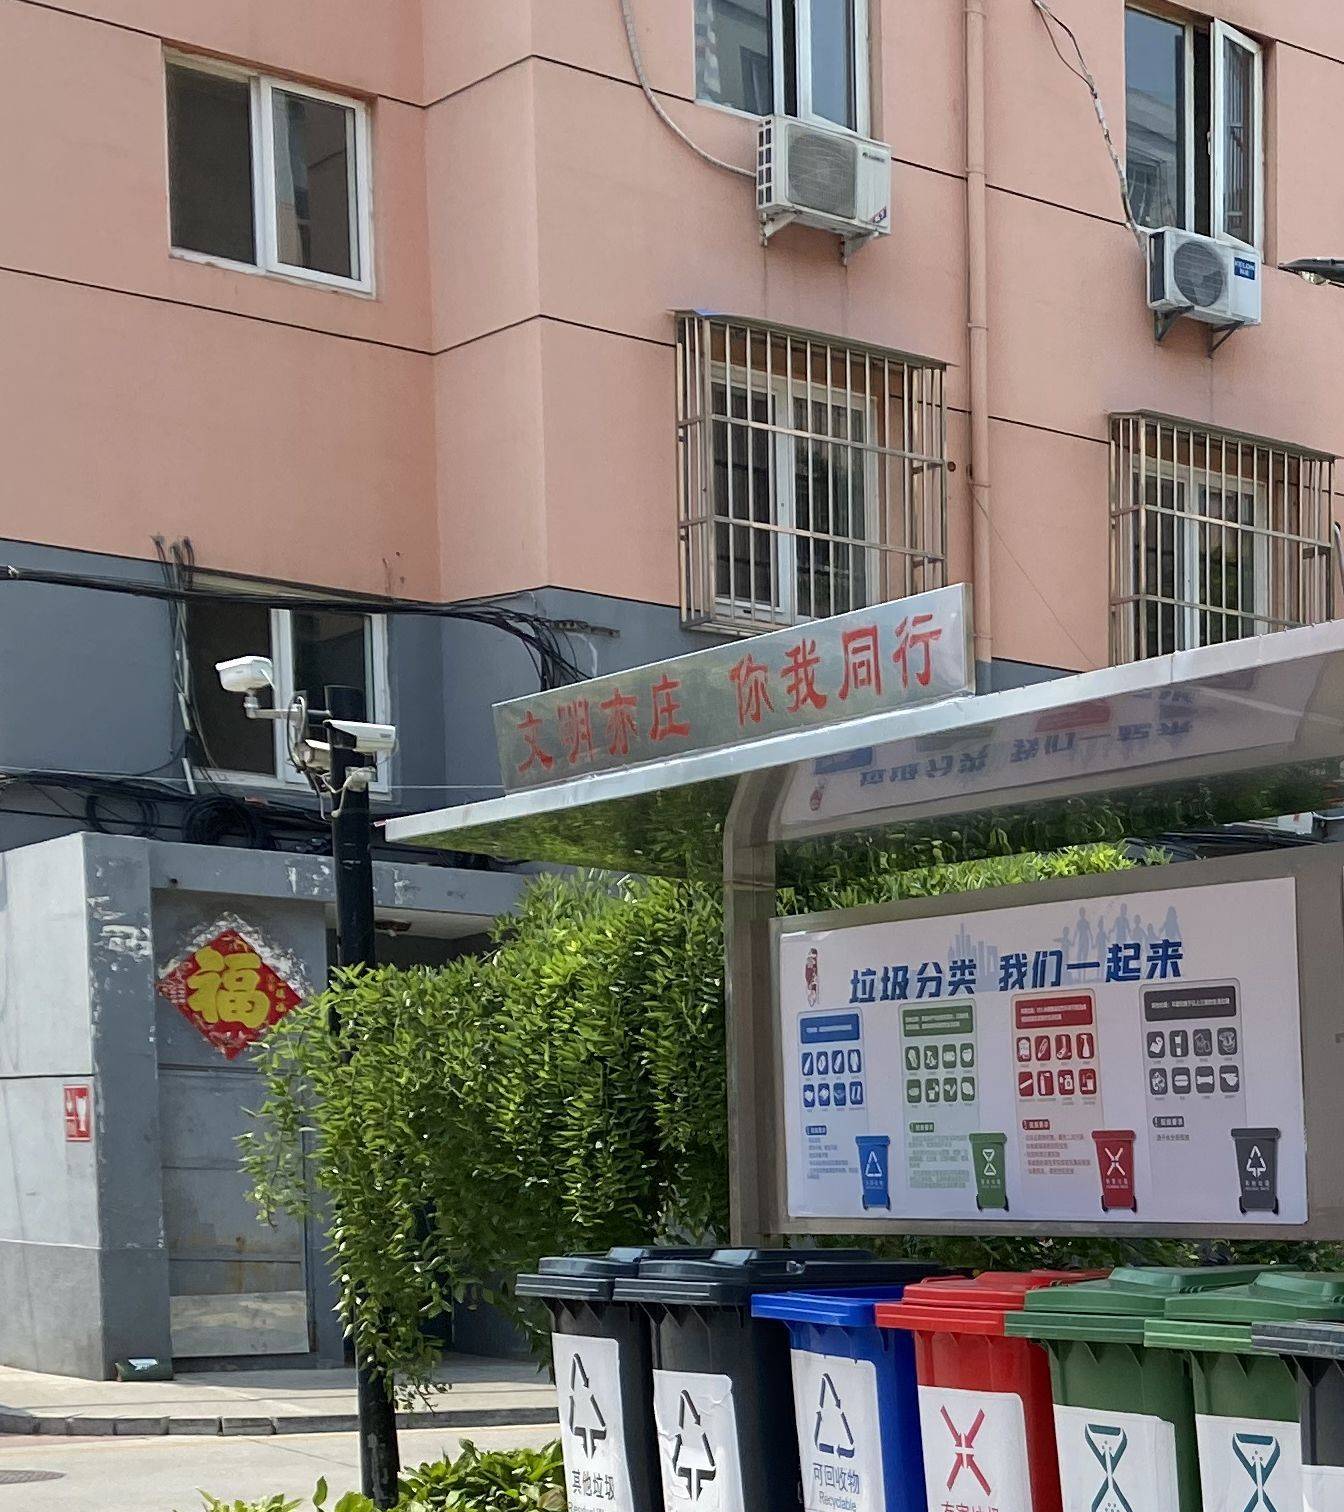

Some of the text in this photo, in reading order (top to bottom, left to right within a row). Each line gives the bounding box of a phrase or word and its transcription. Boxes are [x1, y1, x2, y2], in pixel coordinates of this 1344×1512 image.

[517, 613, 943, 773] 文明亦庄 你我同行
[187, 945, 270, 1029] 福
[848, 957, 978, 1005] 垃圾分类
[999, 938, 1184, 992] 我们一起来
[571, 1468, 615, 1501] 其他垃圾
[812, 1462, 860, 1495] 可回收物
[818, 1490, 857, 1512] Recyclable
